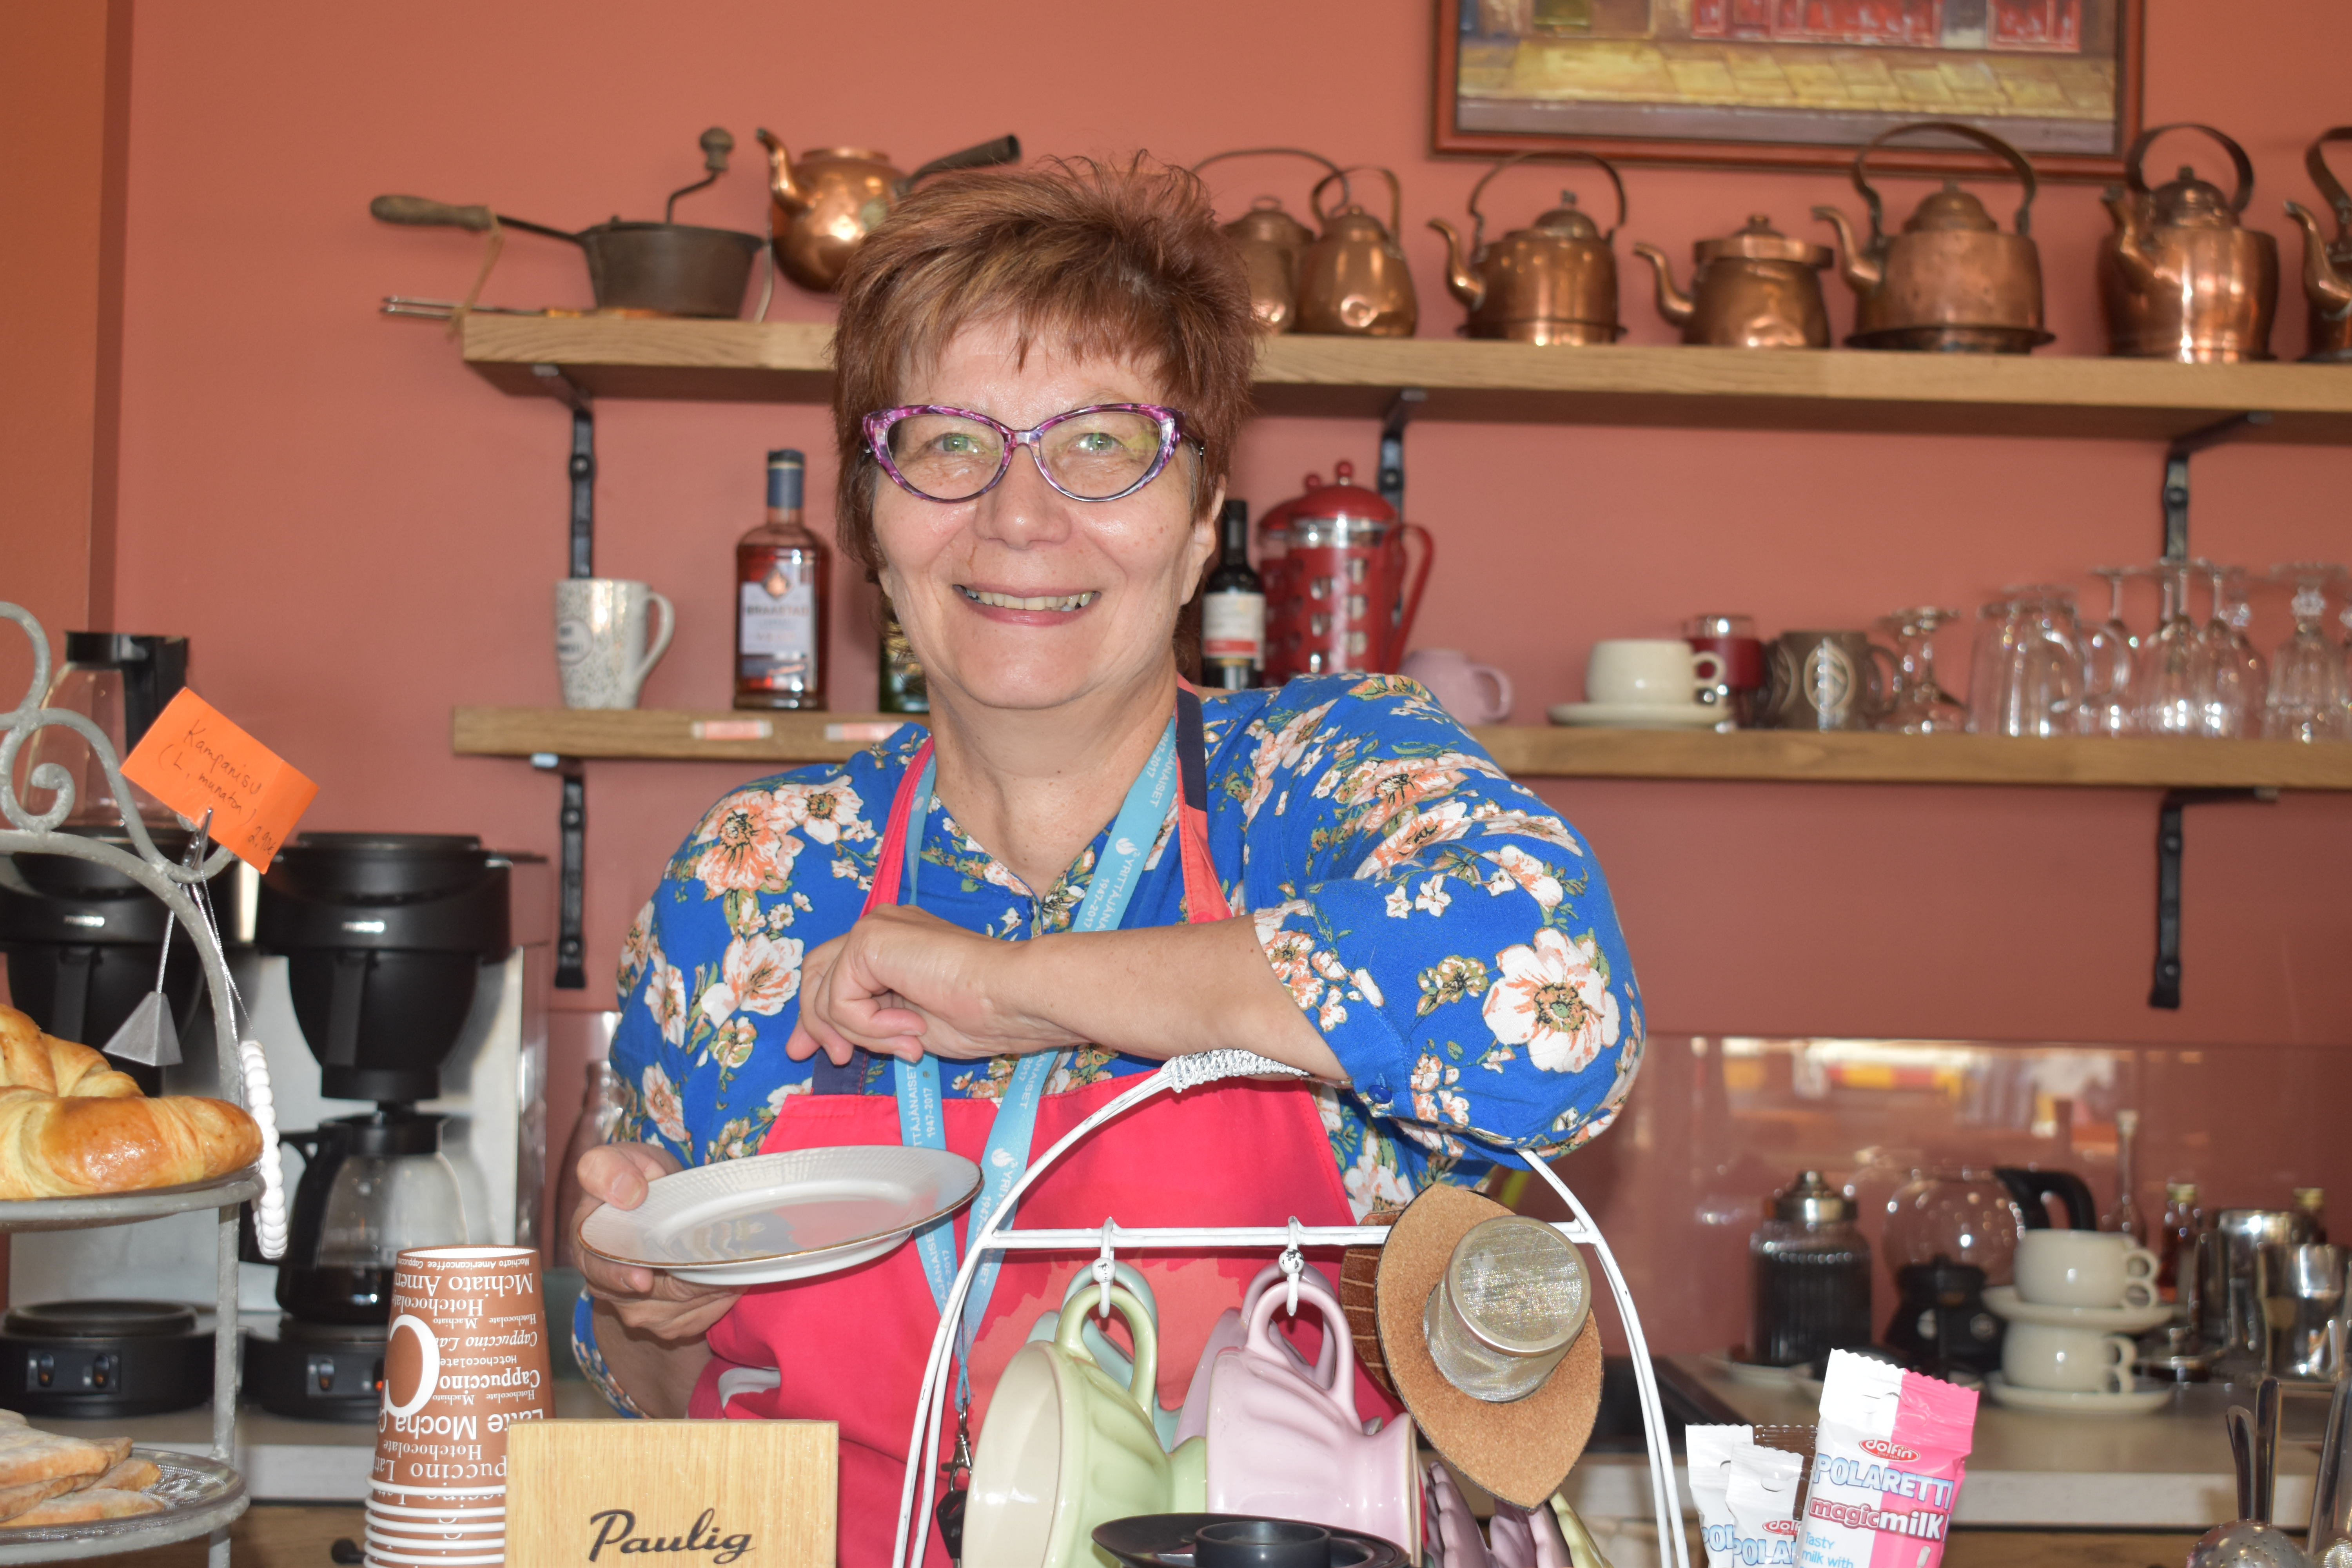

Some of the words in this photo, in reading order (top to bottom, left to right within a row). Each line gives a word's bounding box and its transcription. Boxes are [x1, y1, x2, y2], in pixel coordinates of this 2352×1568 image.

[1149, 732, 1169, 779] 1947-2017
[1083, 878, 1110, 929] 1947-2017
[923, 1088, 936, 1138] 1947-2017
[427, 1260, 496, 1270] Americancoffee
[499, 1258, 530, 1267] Machiato
[448, 1273, 534, 1298] Mchiato
[433, 1318, 478, 1329] Machiato
[489, 1313, 537, 1328] Hotchocolate
[466, 1329, 538, 1351] Cappuccino
[440, 1355, 517, 1368] Hotchocolate
[440, 1367, 541, 1394] Cappuccino
[433, 1394, 475, 1405] Machiato
[486, 1390, 535, 1404] Hotchocolate
[396, 1416, 477, 1440] Mocha
[383, 1439, 482, 1461] Hotchocolate
[1865, 1440, 1913, 1459] dolfin
[1813, 1453, 1954, 1510] POLARETTI
[589, 1507, 757, 1564] Paulig
[1806, 1531, 1835, 1550] Tasty
[1802, 1550, 1824, 1564] milk
[1828, 1557, 1854, 1568] with
